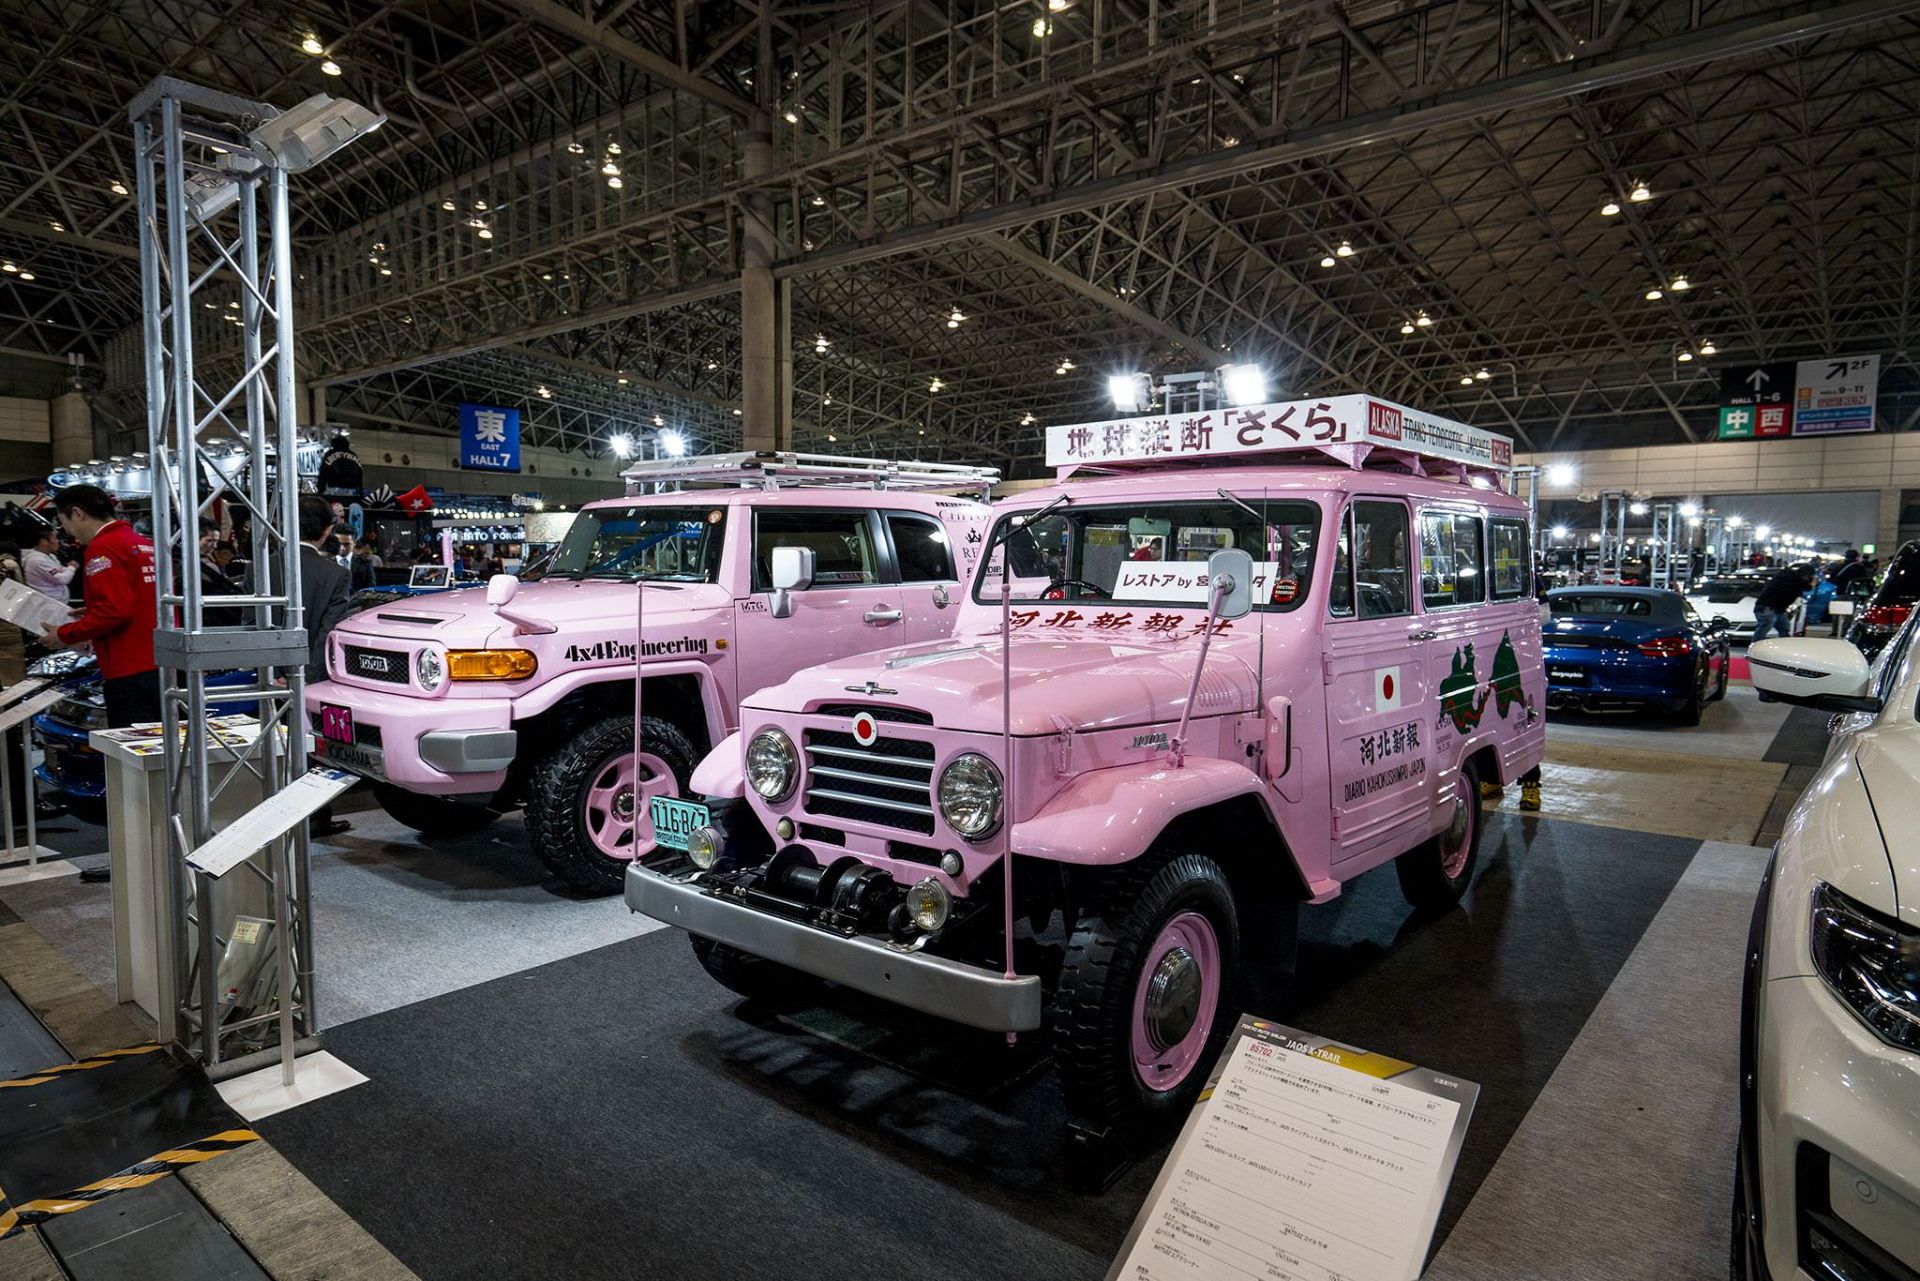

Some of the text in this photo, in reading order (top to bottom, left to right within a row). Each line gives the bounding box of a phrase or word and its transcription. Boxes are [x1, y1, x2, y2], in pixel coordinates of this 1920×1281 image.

[1851, 359, 1870, 370] 2F
[474, 410, 506, 442] 東
[1371, 406, 1400, 436] ALASKA
[1726, 410, 1748, 429] 中
[1760, 408, 1785, 427] 西
[1403, 417, 1427, 443] TRANS
[481, 443, 500, 451] EAST
[470, 453, 510, 467] HALL 7
[1123, 574, 1175, 587] レストア
[1177, 577, 1191, 588] by
[1007, 610, 1234, 637] 河北新報社
[359, 655, 388, 672] TOYOTA
[1360, 722, 1420, 766] 河北新報
[1344, 781, 1366, 802] DIARIO
[1285, 1039, 1342, 1063] JAOS X-TRAIL
